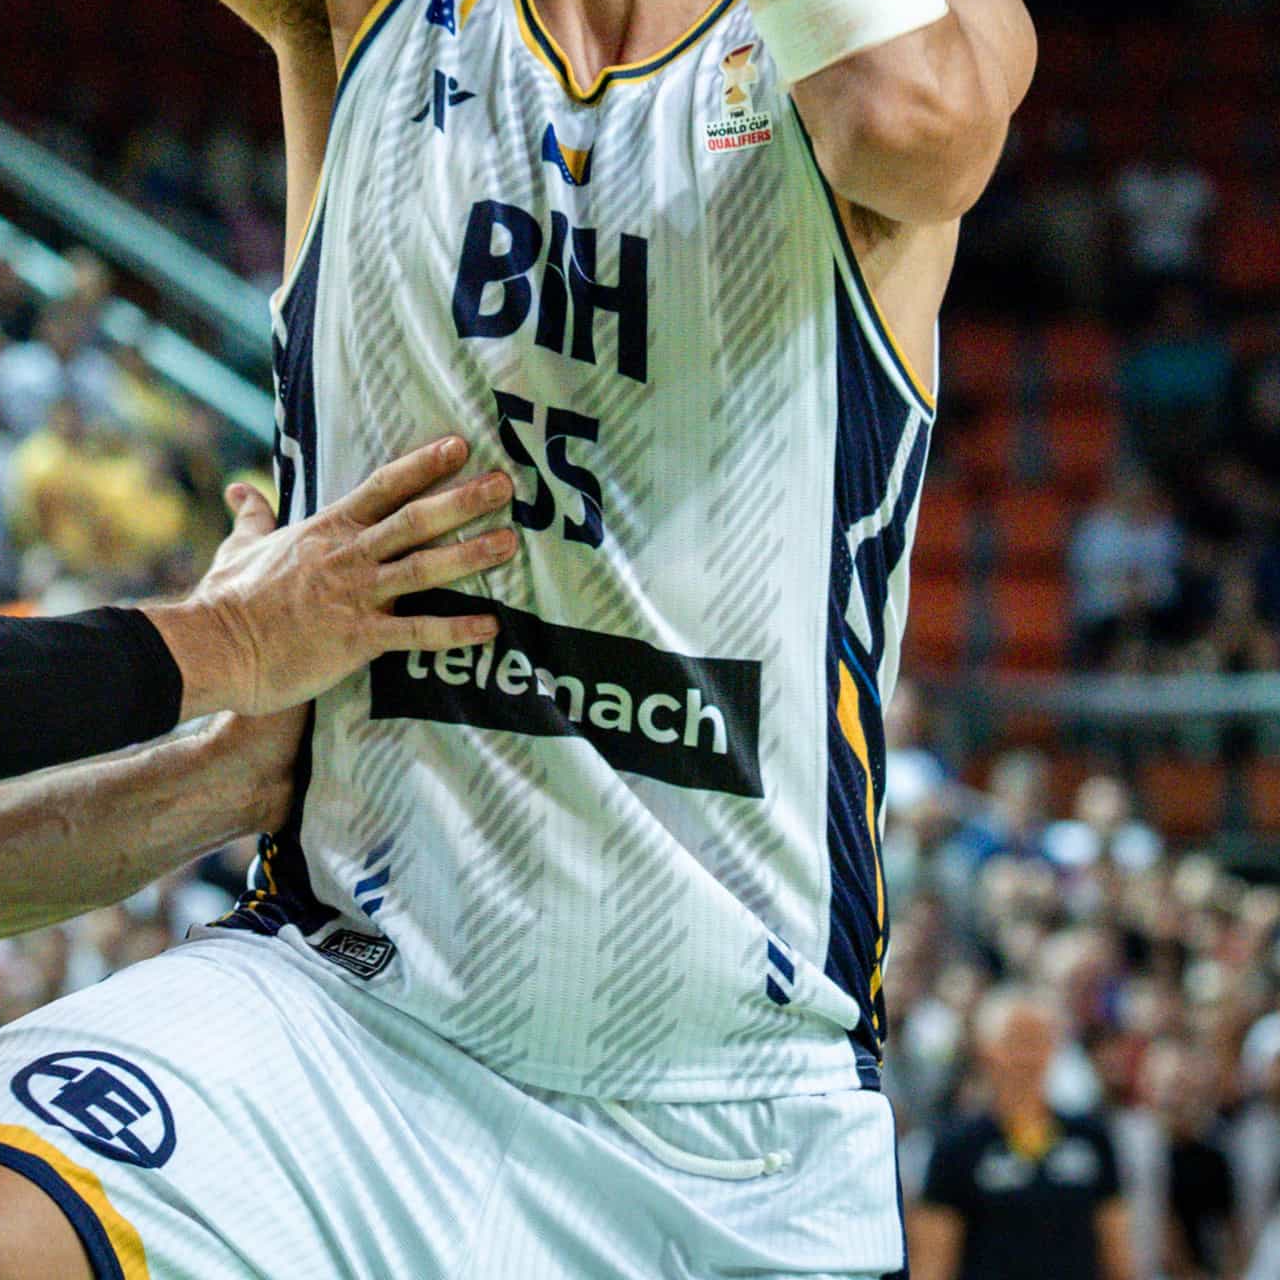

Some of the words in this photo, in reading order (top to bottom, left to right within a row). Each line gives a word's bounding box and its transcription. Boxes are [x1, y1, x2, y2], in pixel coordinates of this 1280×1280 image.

[706, 125, 746, 137] WORLD
[749, 119, 769, 130] CUP
[708, 129, 772, 151] QUALIFIERS
[493, 389, 605, 550] 55
